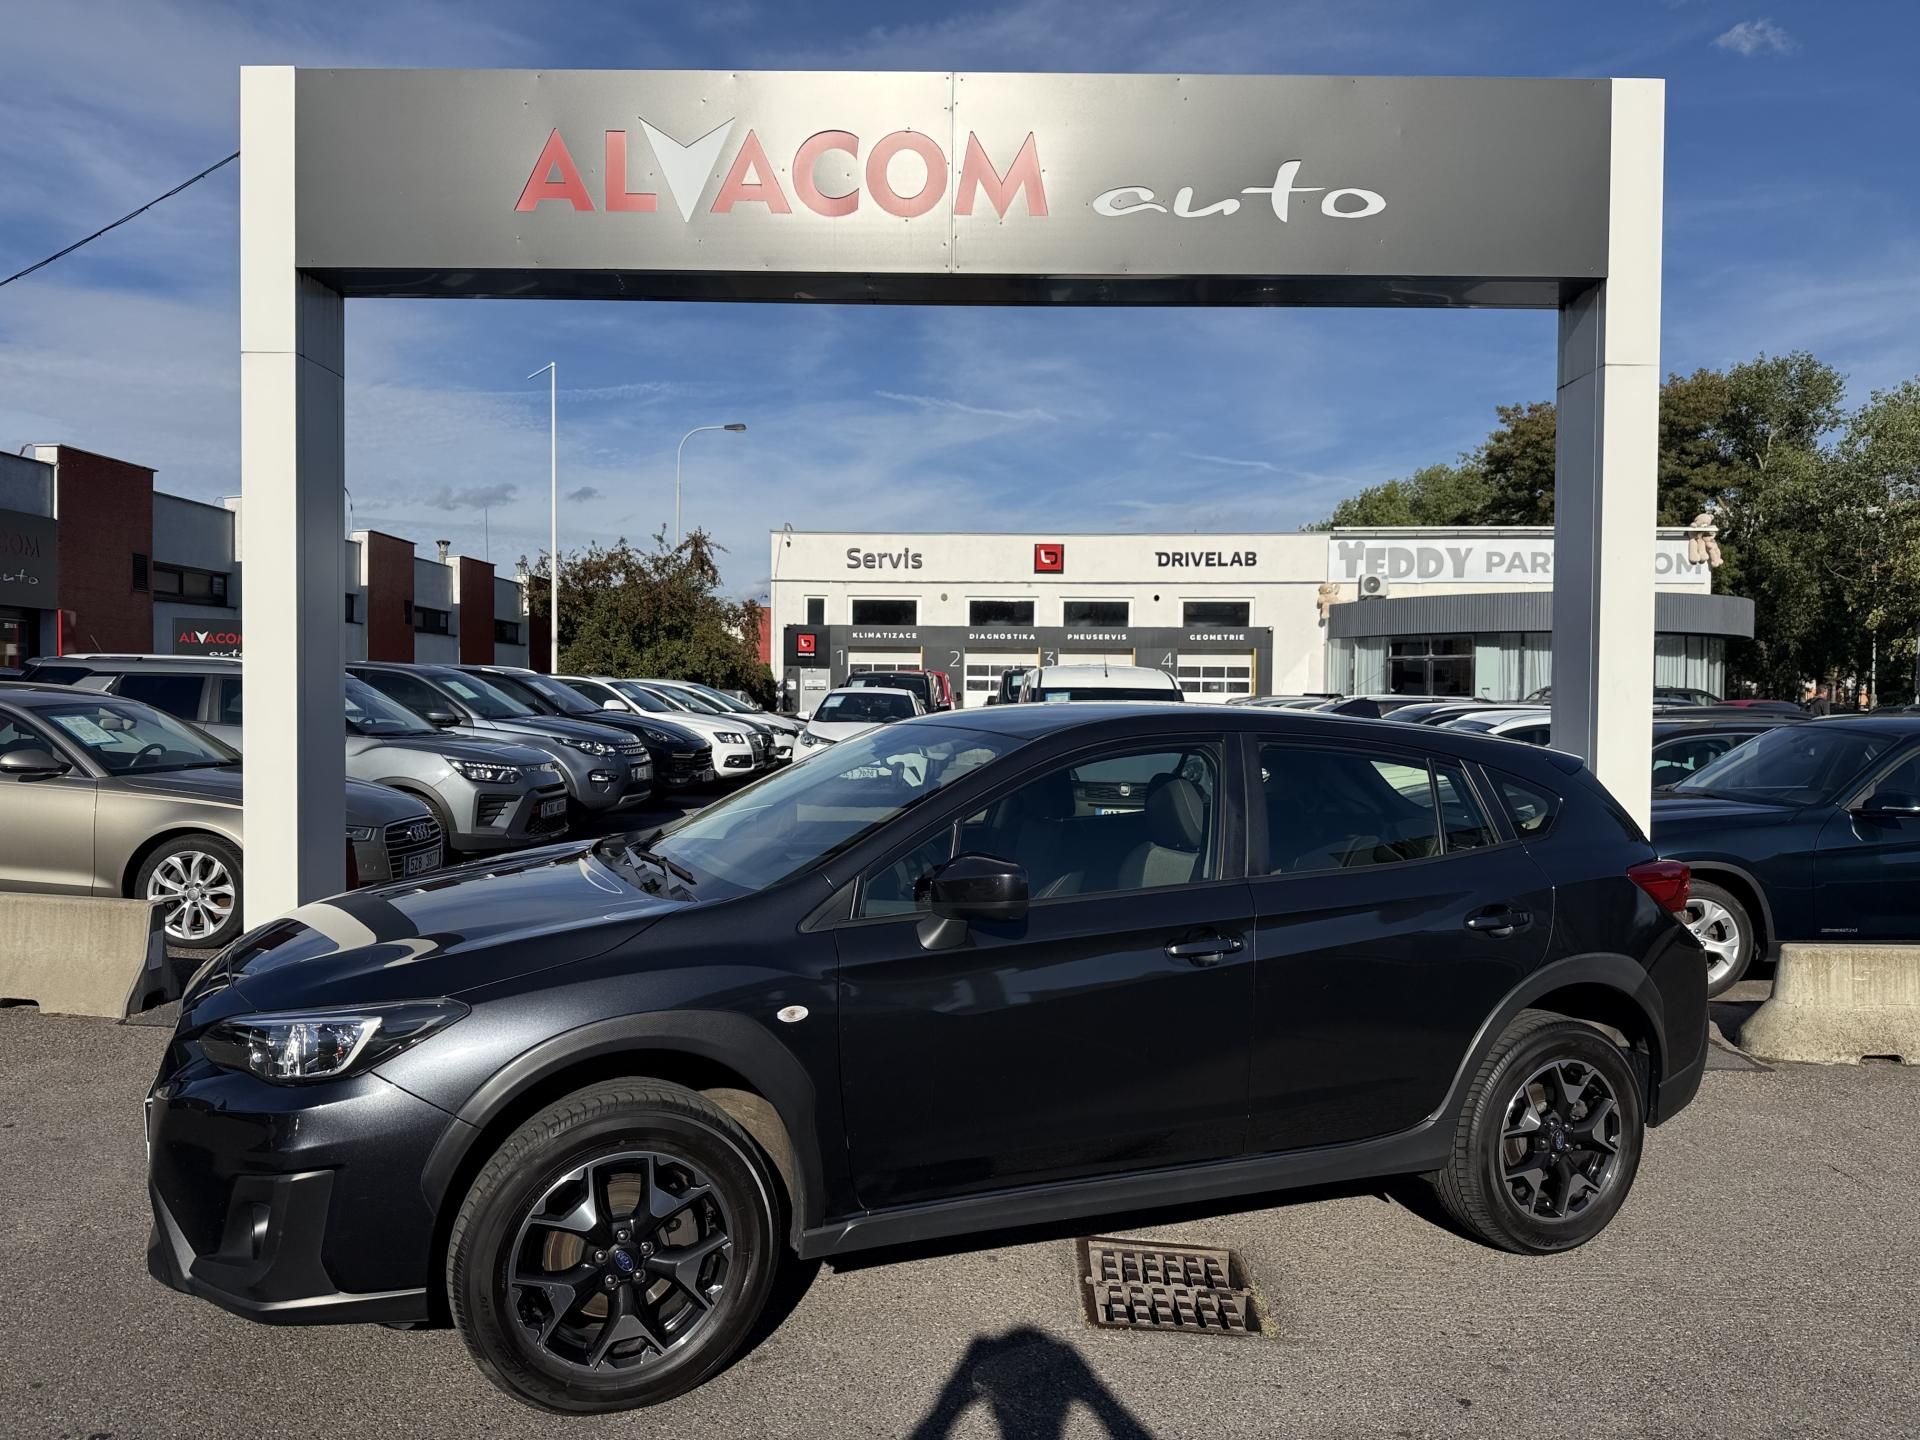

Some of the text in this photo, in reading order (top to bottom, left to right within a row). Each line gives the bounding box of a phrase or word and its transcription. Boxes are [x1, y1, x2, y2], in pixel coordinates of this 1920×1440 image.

[514, 116, 1387, 223] ALVACOM auto
[847, 547, 923, 569] Servis
[1155, 551, 1257, 567] DRIVELAB
[1338, 541, 1702, 578] TEDDY PAR OM
[0, 569, 39, 584] uto
[1067, 633, 1127, 641] PNEUSERVIS
[209, 649, 242, 657] aut
[836, 649, 844, 666] 1
[950, 651, 961, 667] 2
[1044, 651, 1055, 666] 3
[1161, 652, 1173, 668] 4
